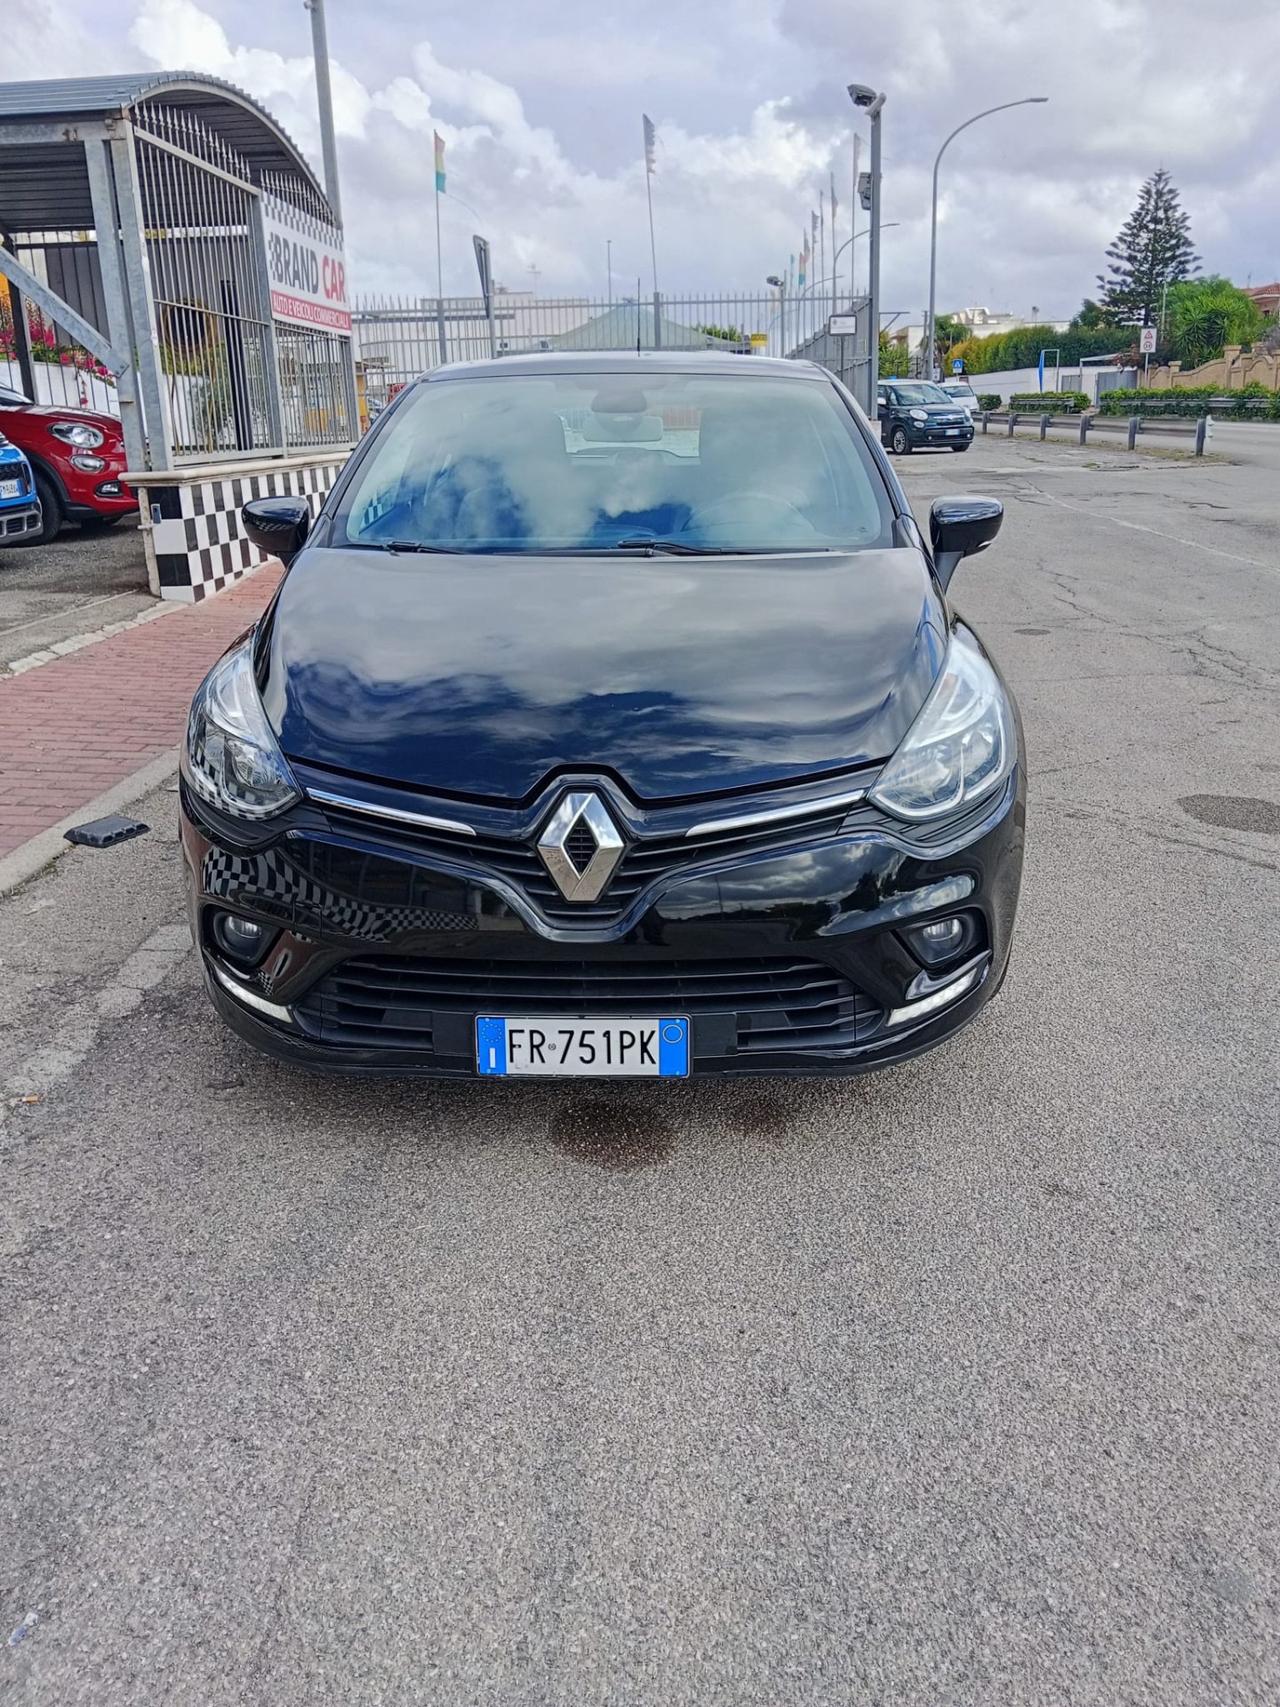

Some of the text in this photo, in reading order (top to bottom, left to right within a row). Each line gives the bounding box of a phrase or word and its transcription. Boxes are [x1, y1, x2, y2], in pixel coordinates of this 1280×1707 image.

[271, 233, 346, 303] BRAND CAR
[273, 294, 288, 313] AUTO
[292, 300, 314, 320] VEICOLI
